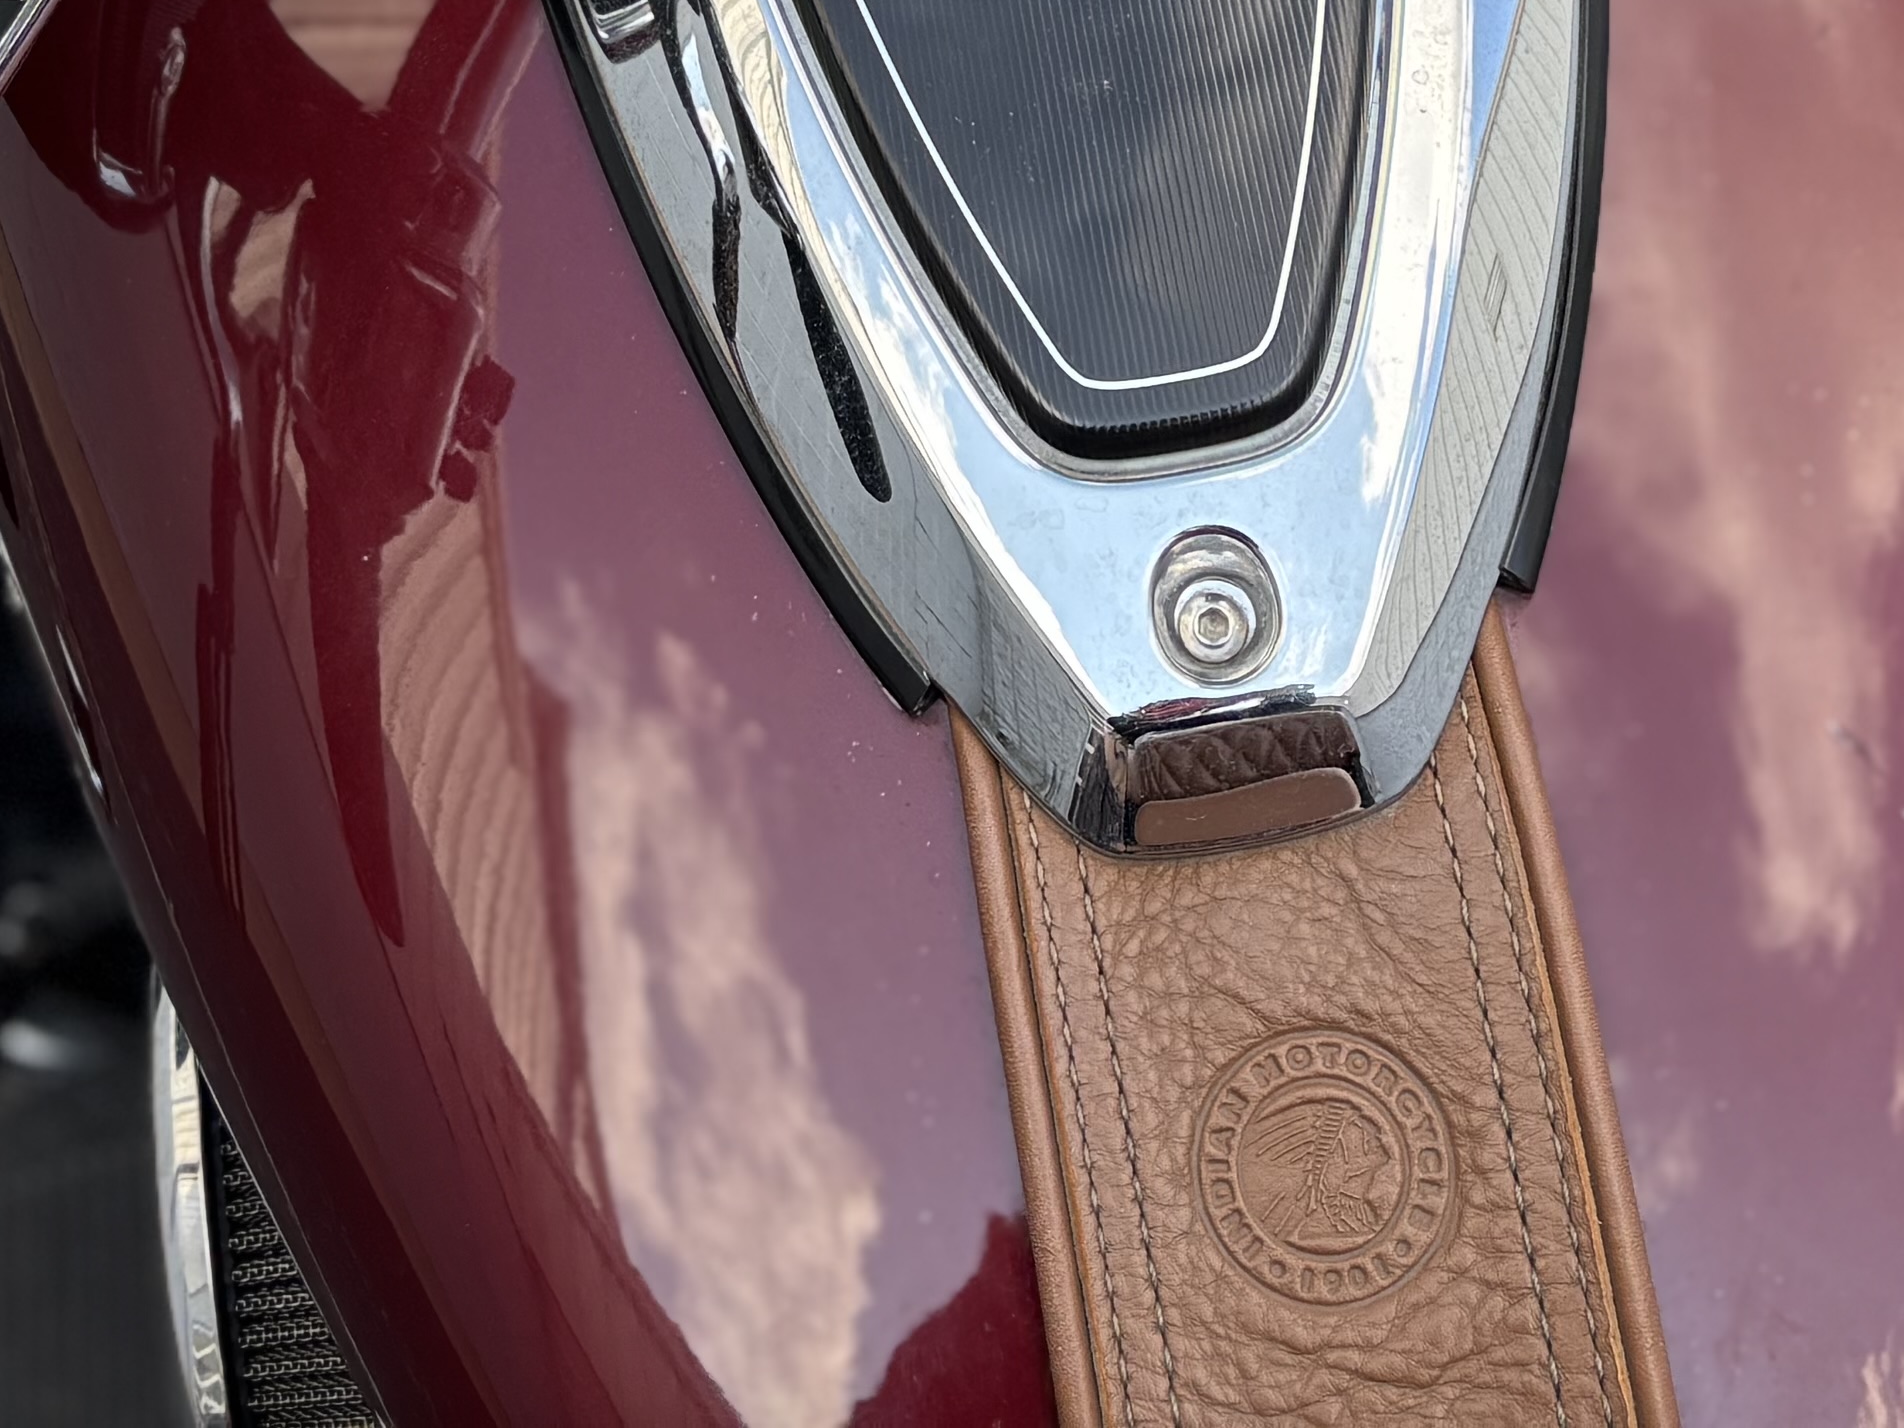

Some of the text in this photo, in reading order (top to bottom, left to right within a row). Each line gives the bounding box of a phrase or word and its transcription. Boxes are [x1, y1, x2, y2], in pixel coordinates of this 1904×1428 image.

[1207, 1045, 1443, 1261] INDIAN MOTORCYCLE
[1300, 1256, 1393, 1295] 1901
